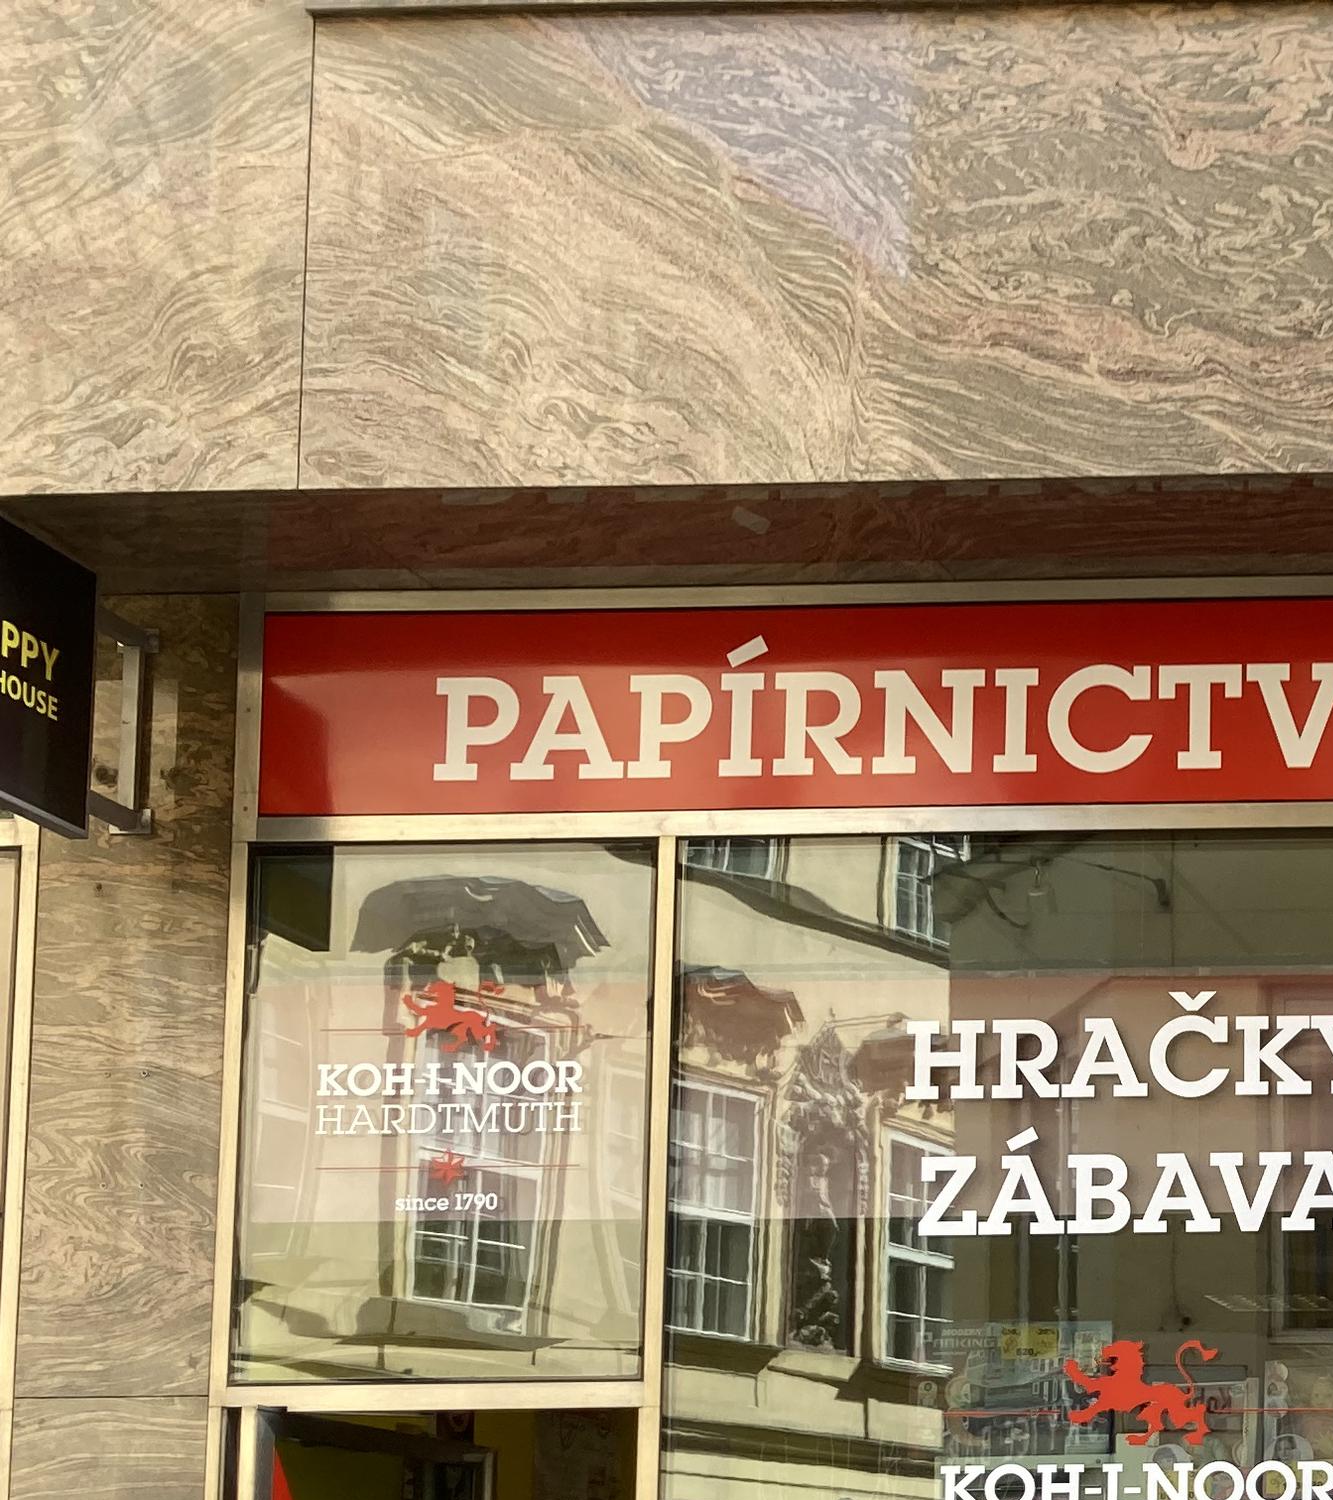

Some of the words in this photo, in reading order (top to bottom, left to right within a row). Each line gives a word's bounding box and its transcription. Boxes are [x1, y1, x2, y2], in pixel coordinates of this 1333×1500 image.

[316, 1060, 583, 1096] KOH-I-NOOR
[315, 1101, 582, 1135] HARDTMUTH
[395, 1193, 449, 1211] since
[454, 1192, 498, 1211] 1790
